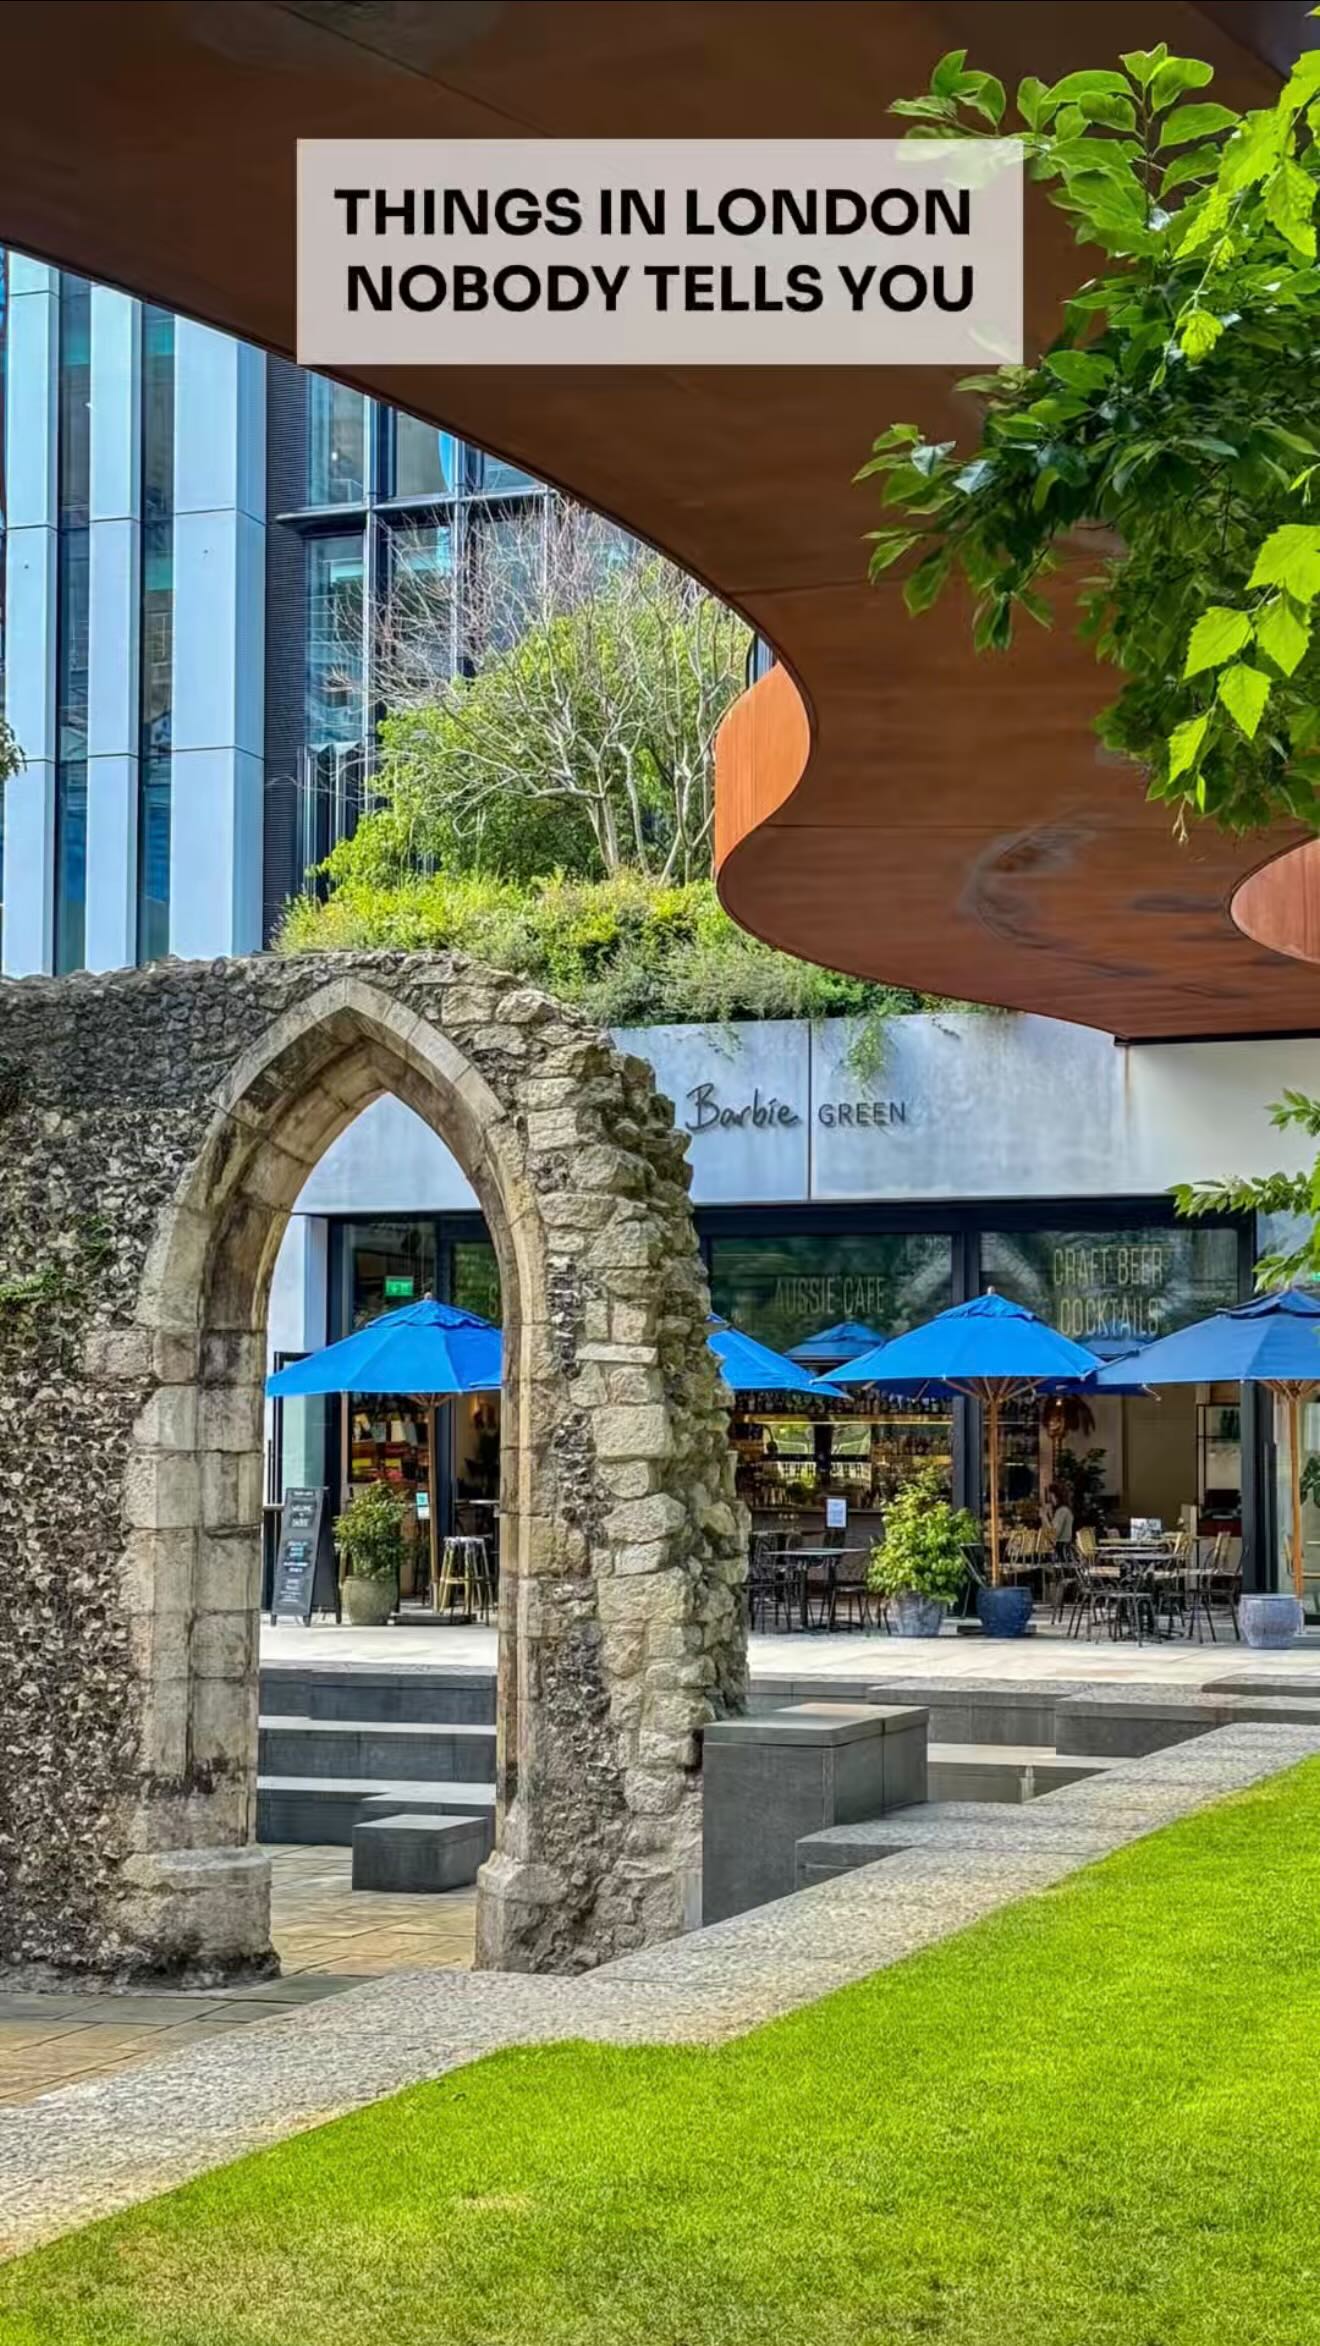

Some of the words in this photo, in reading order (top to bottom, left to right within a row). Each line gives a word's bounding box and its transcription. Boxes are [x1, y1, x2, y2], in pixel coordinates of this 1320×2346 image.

[684, 1083, 799, 1131] Barbie
[818, 1102, 906, 1128] GREEN
[1054, 1247, 1109, 1286] CRAFT
[1118, 1247, 1163, 1286] BEER
[776, 1276, 835, 1314] AUSSIE
[843, 1276, 884, 1314] CAFE
[1060, 1297, 1159, 1336] COCKTAILS
